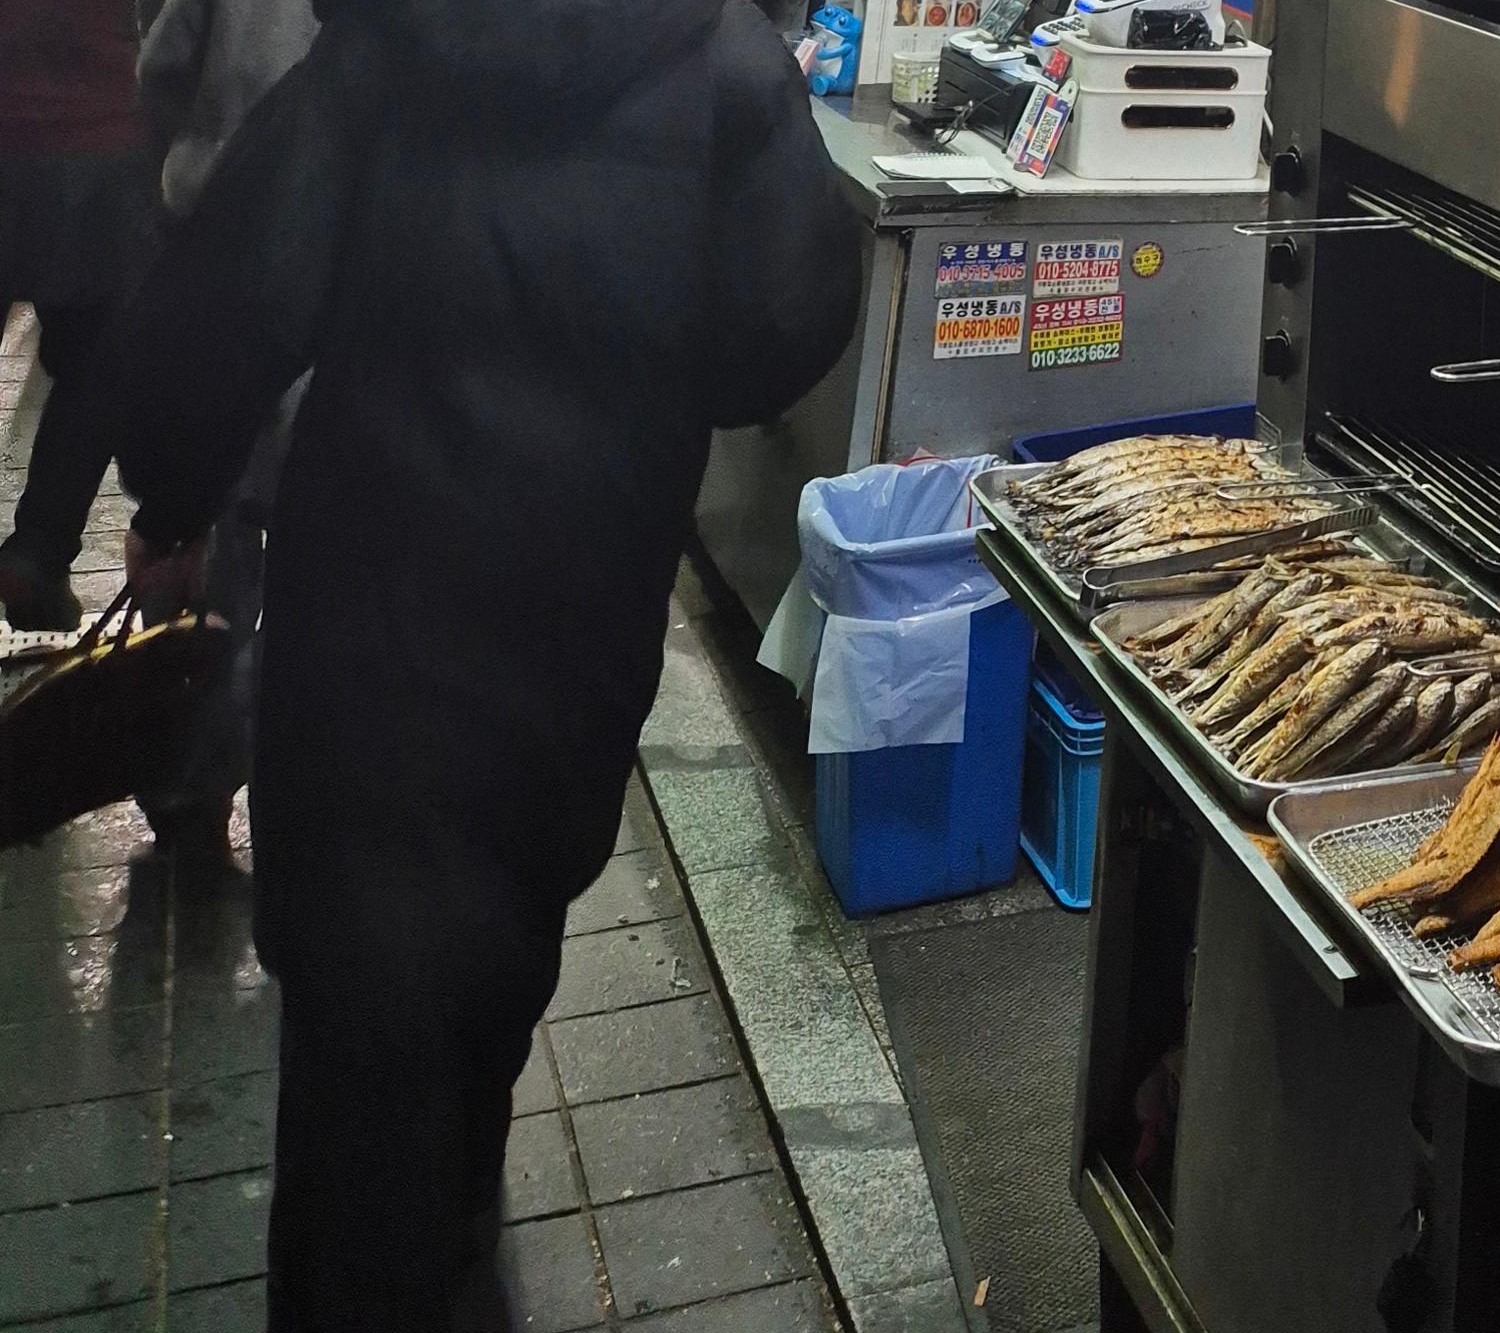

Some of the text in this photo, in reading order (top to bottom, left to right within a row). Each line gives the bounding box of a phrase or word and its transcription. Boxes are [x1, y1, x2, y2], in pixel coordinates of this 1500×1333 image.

[942, 242, 1025, 260] 우성냉동
[1040, 243, 1119, 261] 우성냉동 A/S
[1038, 260, 1119, 279] 010-5204-8775
[942, 299, 1021, 318] 우성냉동 A/S
[1035, 299, 1098, 321] 우성냉동
[939, 317, 1020, 340] 010-6870-1600
[1031, 343, 1120, 368] 010-3233-6622
